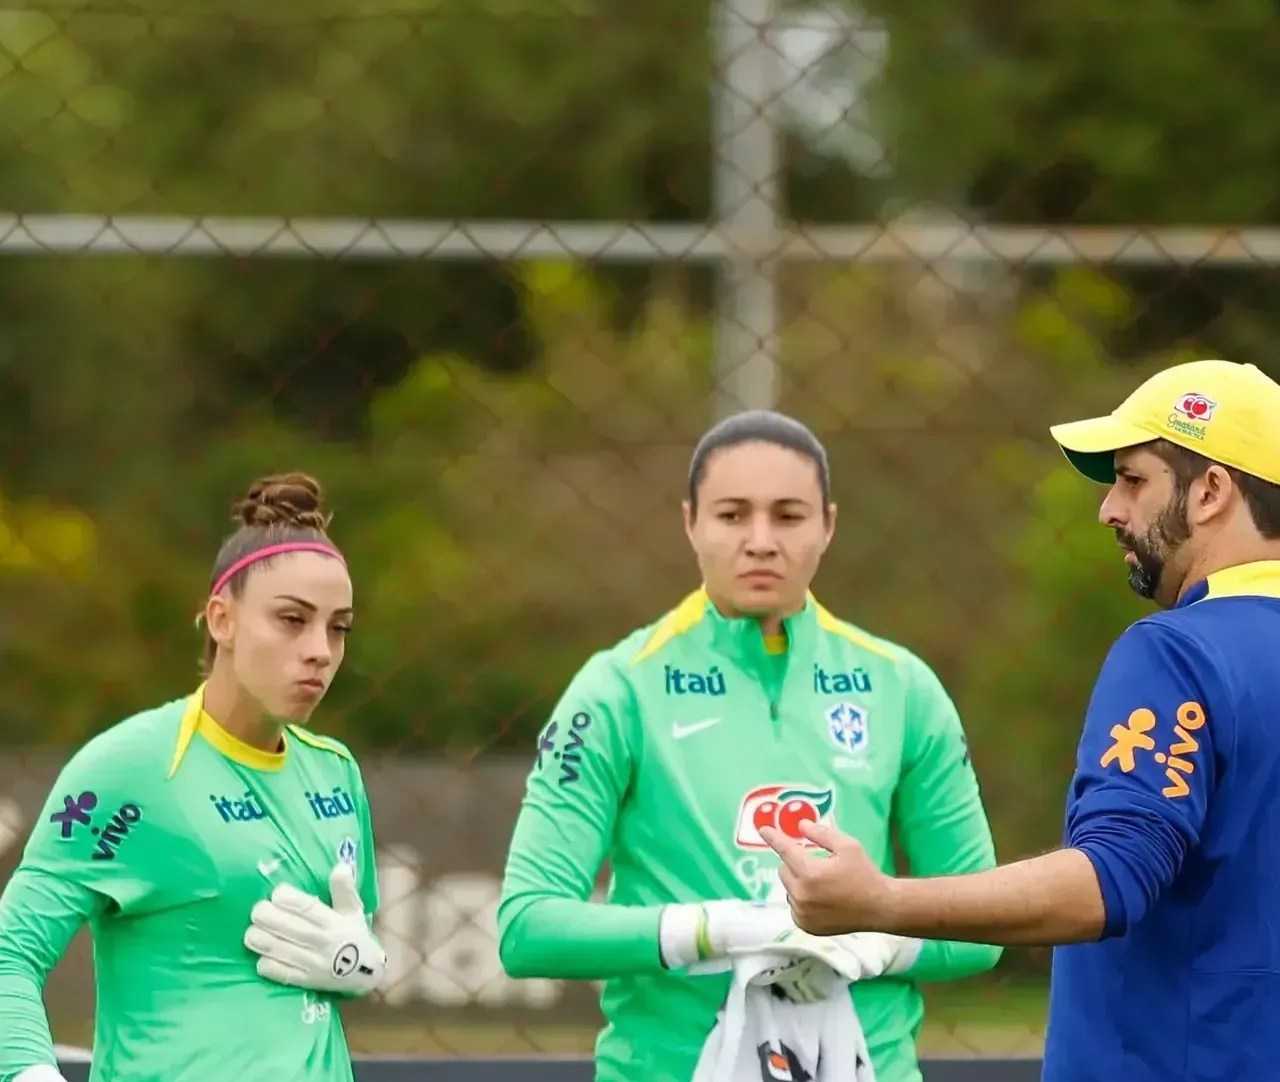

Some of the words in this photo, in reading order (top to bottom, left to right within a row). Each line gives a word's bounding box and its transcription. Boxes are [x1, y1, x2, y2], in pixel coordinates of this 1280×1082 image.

[664, 664, 727, 696] itaú
[813, 663, 872, 694] itaú
[559, 711, 591, 786] vivo
[1163, 701, 1206, 797] vivo
[209, 791, 268, 823] itaú
[304, 787, 355, 821] itaú
